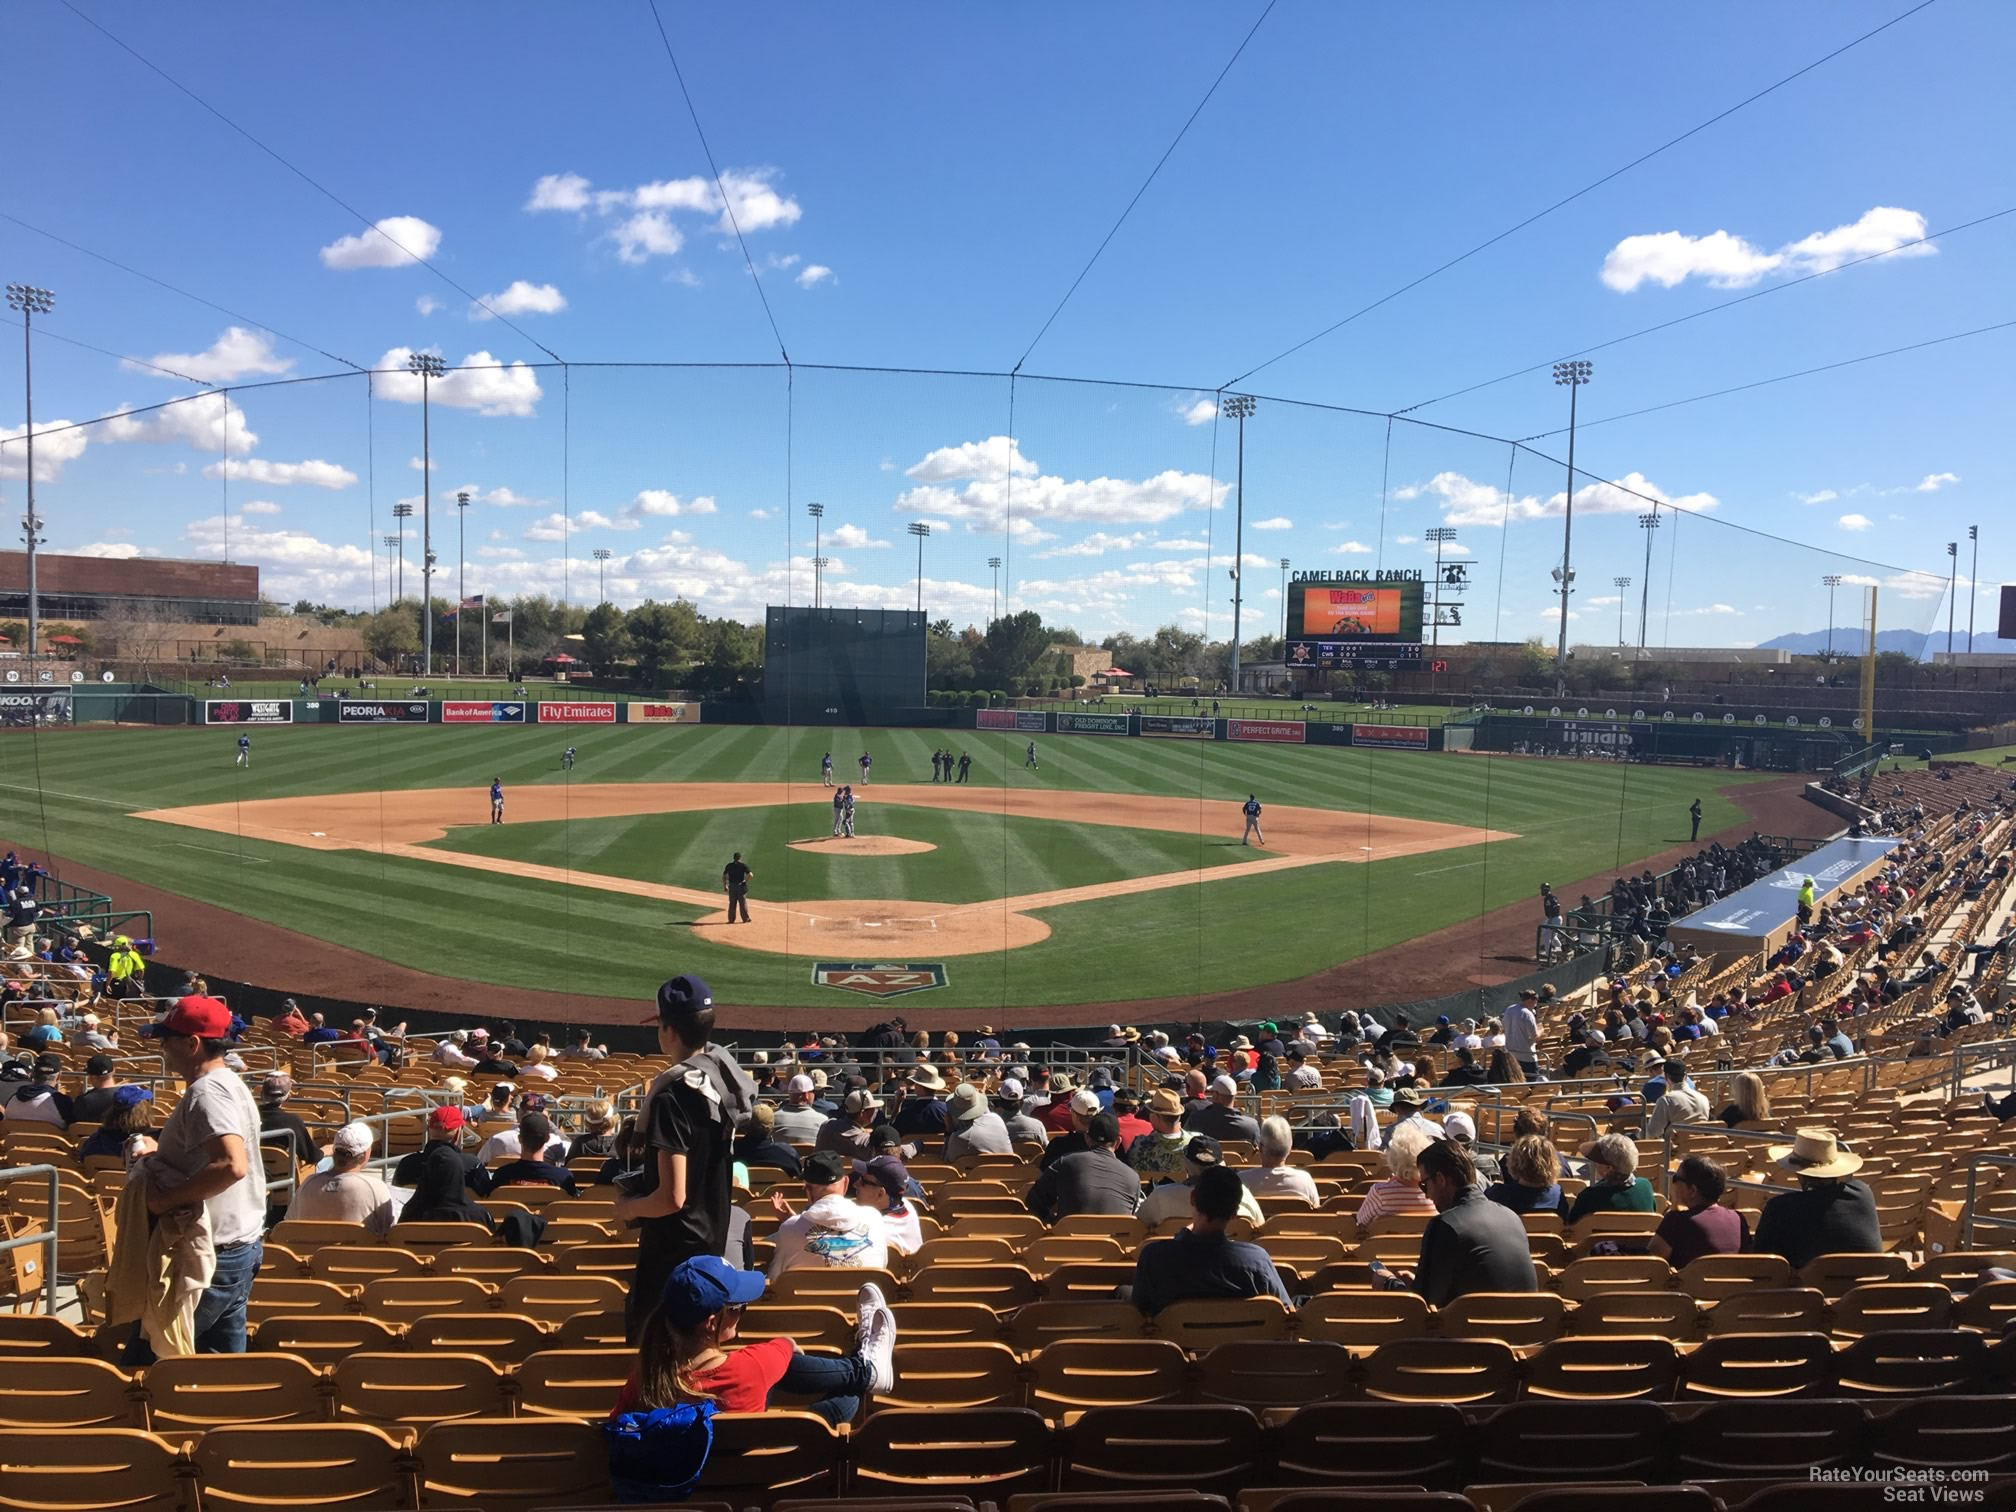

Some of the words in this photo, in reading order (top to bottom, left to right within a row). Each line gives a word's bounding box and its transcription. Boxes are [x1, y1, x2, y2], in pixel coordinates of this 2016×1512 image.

[1292, 570, 1369, 583] CAMELBACK
[1376, 569, 1422, 582] RANCH
[1432, 661, 1447, 672] 127
[251, 703, 280, 713] WESTGATE
[343, 706, 385, 716] PEORIA
[446, 708, 464, 716] Bank
[464, 708, 472, 716] of
[472, 708, 502, 717] America
[543, 706, 562, 719] Fly
[564, 705, 612, 718] Emirates
[1242, 726, 1271, 735] PERFECT
[839, 974, 923, 986] AZ
[1996, 1015, 2006, 1023] 13
[1720, 1062, 1728, 1071] 14
